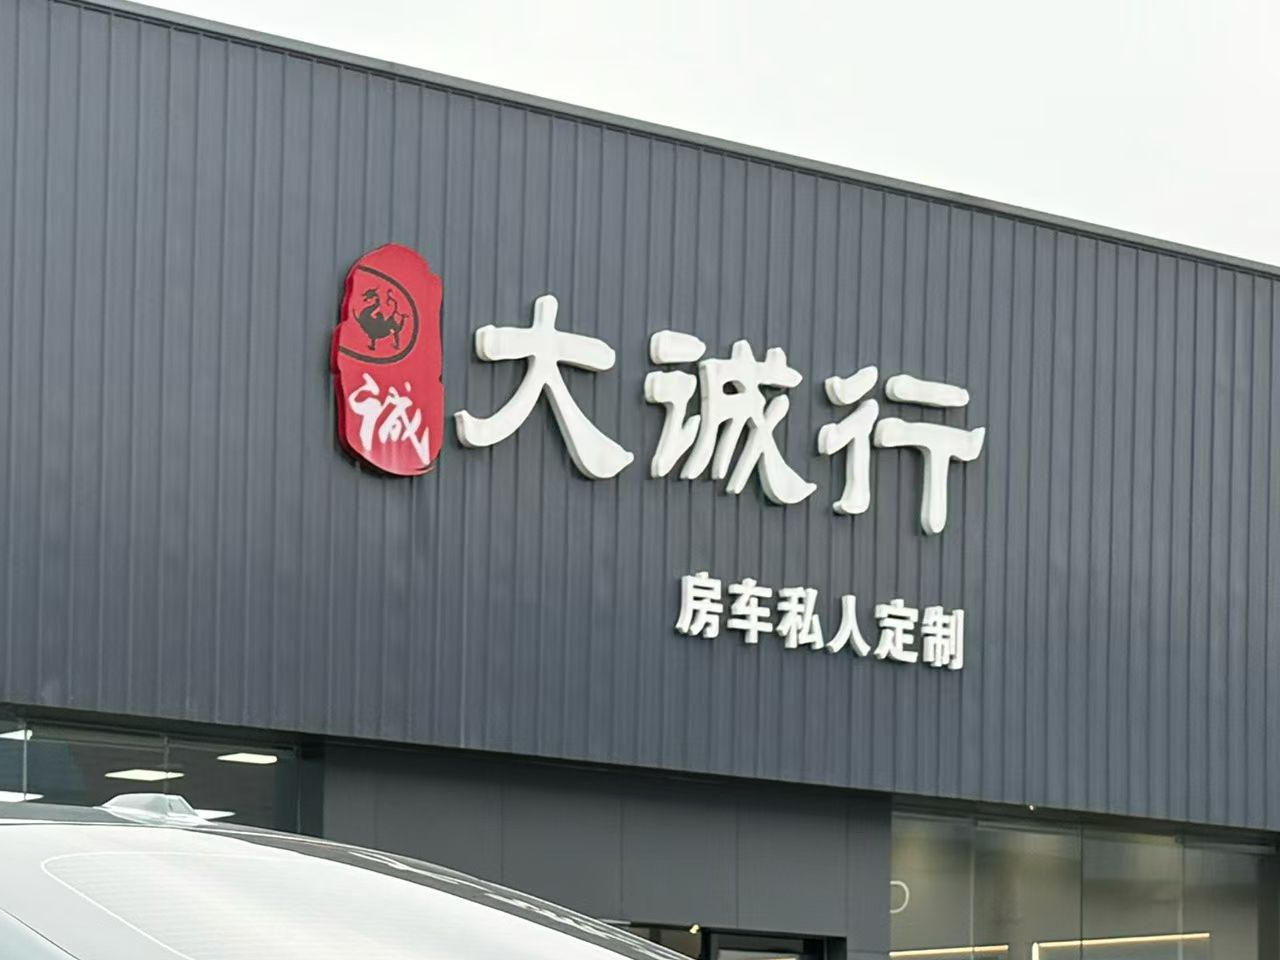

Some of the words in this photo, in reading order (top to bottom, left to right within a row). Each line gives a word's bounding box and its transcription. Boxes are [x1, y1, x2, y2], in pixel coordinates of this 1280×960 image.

[454, 294, 986, 535] 大诚行
[675, 571, 965, 670] 房车私人定制
